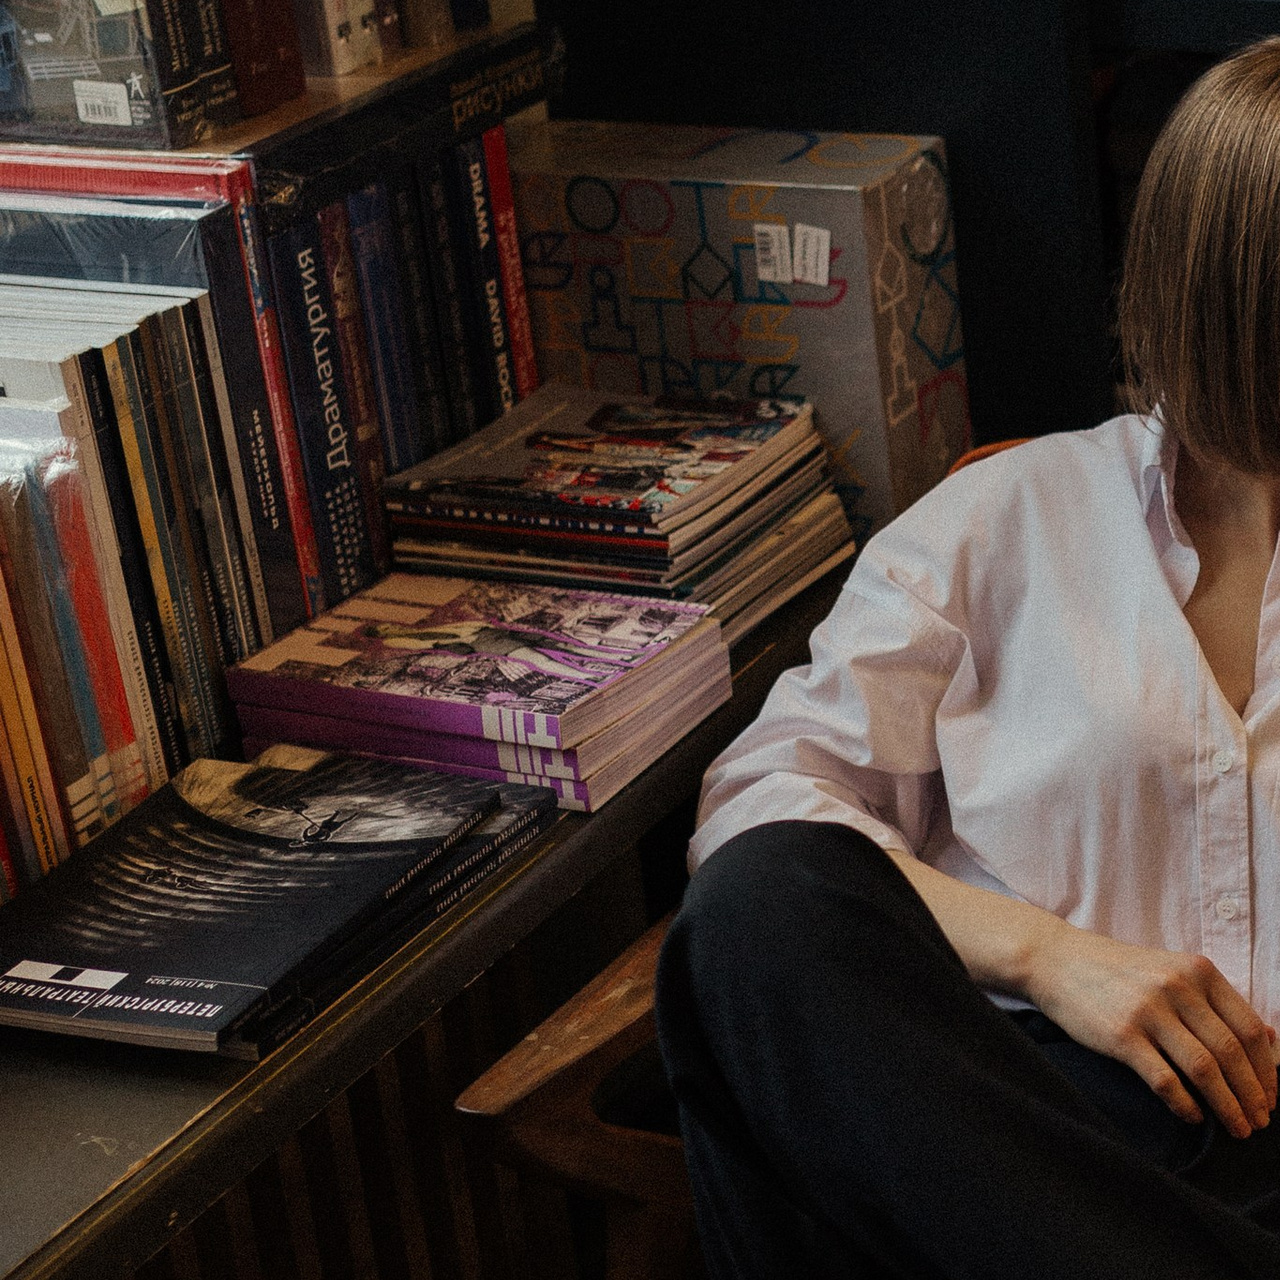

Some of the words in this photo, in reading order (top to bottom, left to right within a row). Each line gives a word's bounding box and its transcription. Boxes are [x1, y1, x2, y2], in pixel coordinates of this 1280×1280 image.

[469, 162, 490, 250] DRAMA
[485, 278, 504, 348] DAVID
[297, 248, 351, 470] Драматургия
[251, 408, 279, 530] МЕЙЕРХОЛЬД
[94, 993, 224, 1018] ПЕТЕРБУРГСКИЙ
